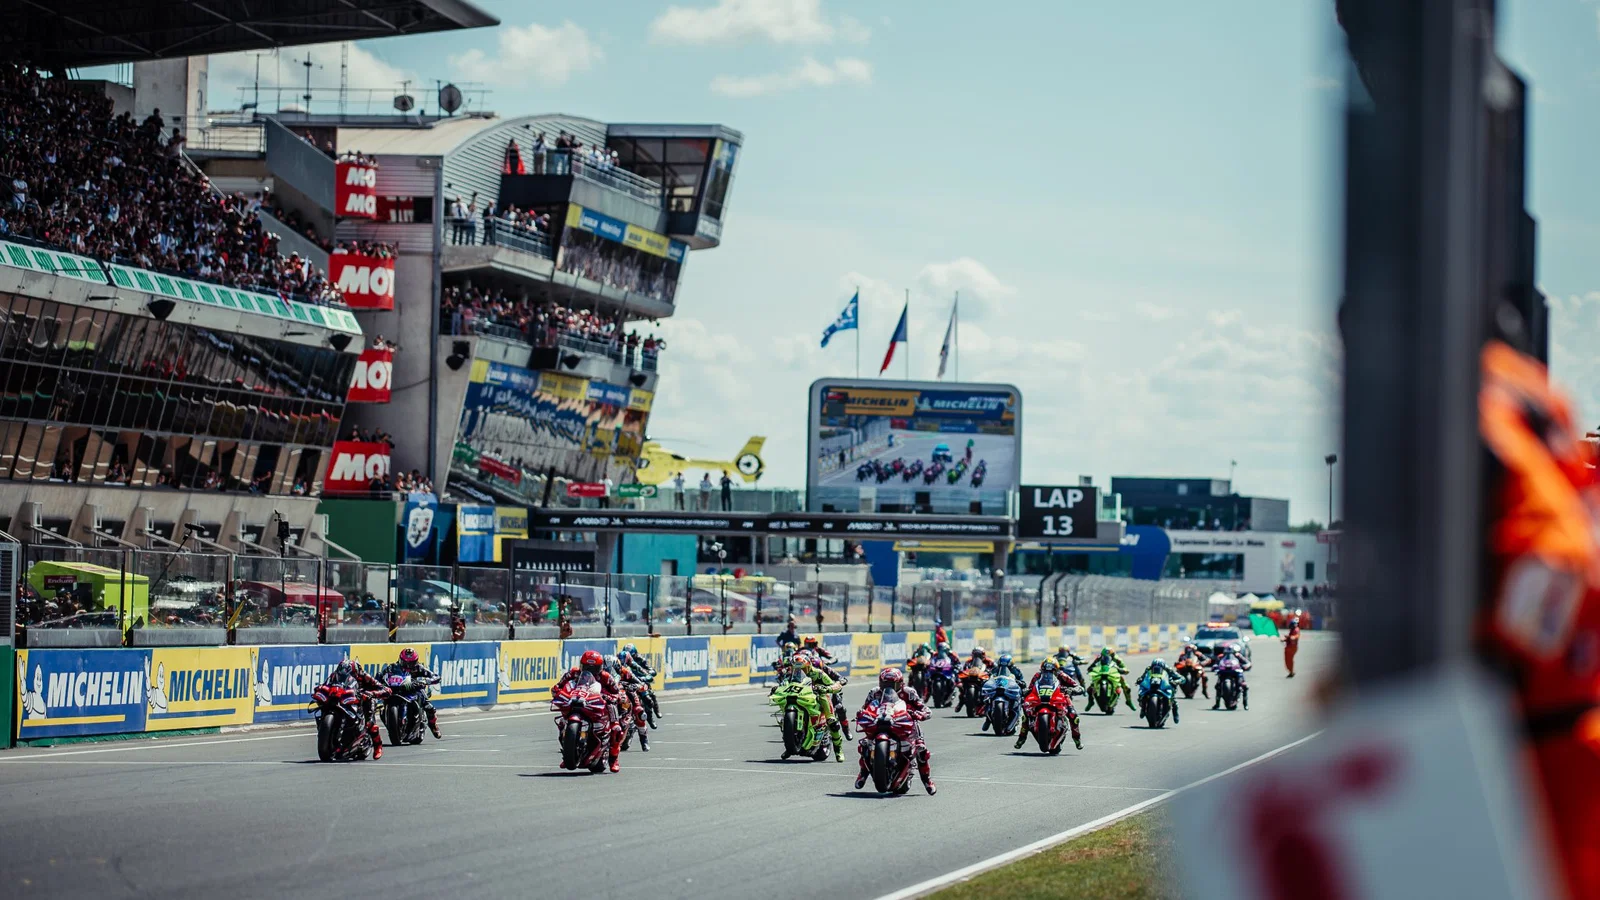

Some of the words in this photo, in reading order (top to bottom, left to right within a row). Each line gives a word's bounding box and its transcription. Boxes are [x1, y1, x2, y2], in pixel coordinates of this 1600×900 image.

[933, 398, 998, 410] MICHELIN
[1034, 488, 1083, 509] LAP
[1042, 515, 1073, 536] 13
[510, 656, 558, 682] MICHELIN
[672, 649, 708, 672] MICHELIN
[717, 648, 748, 668] MICHELIN
[272, 664, 339, 696] MICHELI
[441, 658, 496, 687] MICHELIN
[47, 671, 144, 708] MICHELIN
[168, 668, 251, 702] MICHELIN
[784, 685, 804, 694] 49
[1038, 688, 1054, 696] 36
